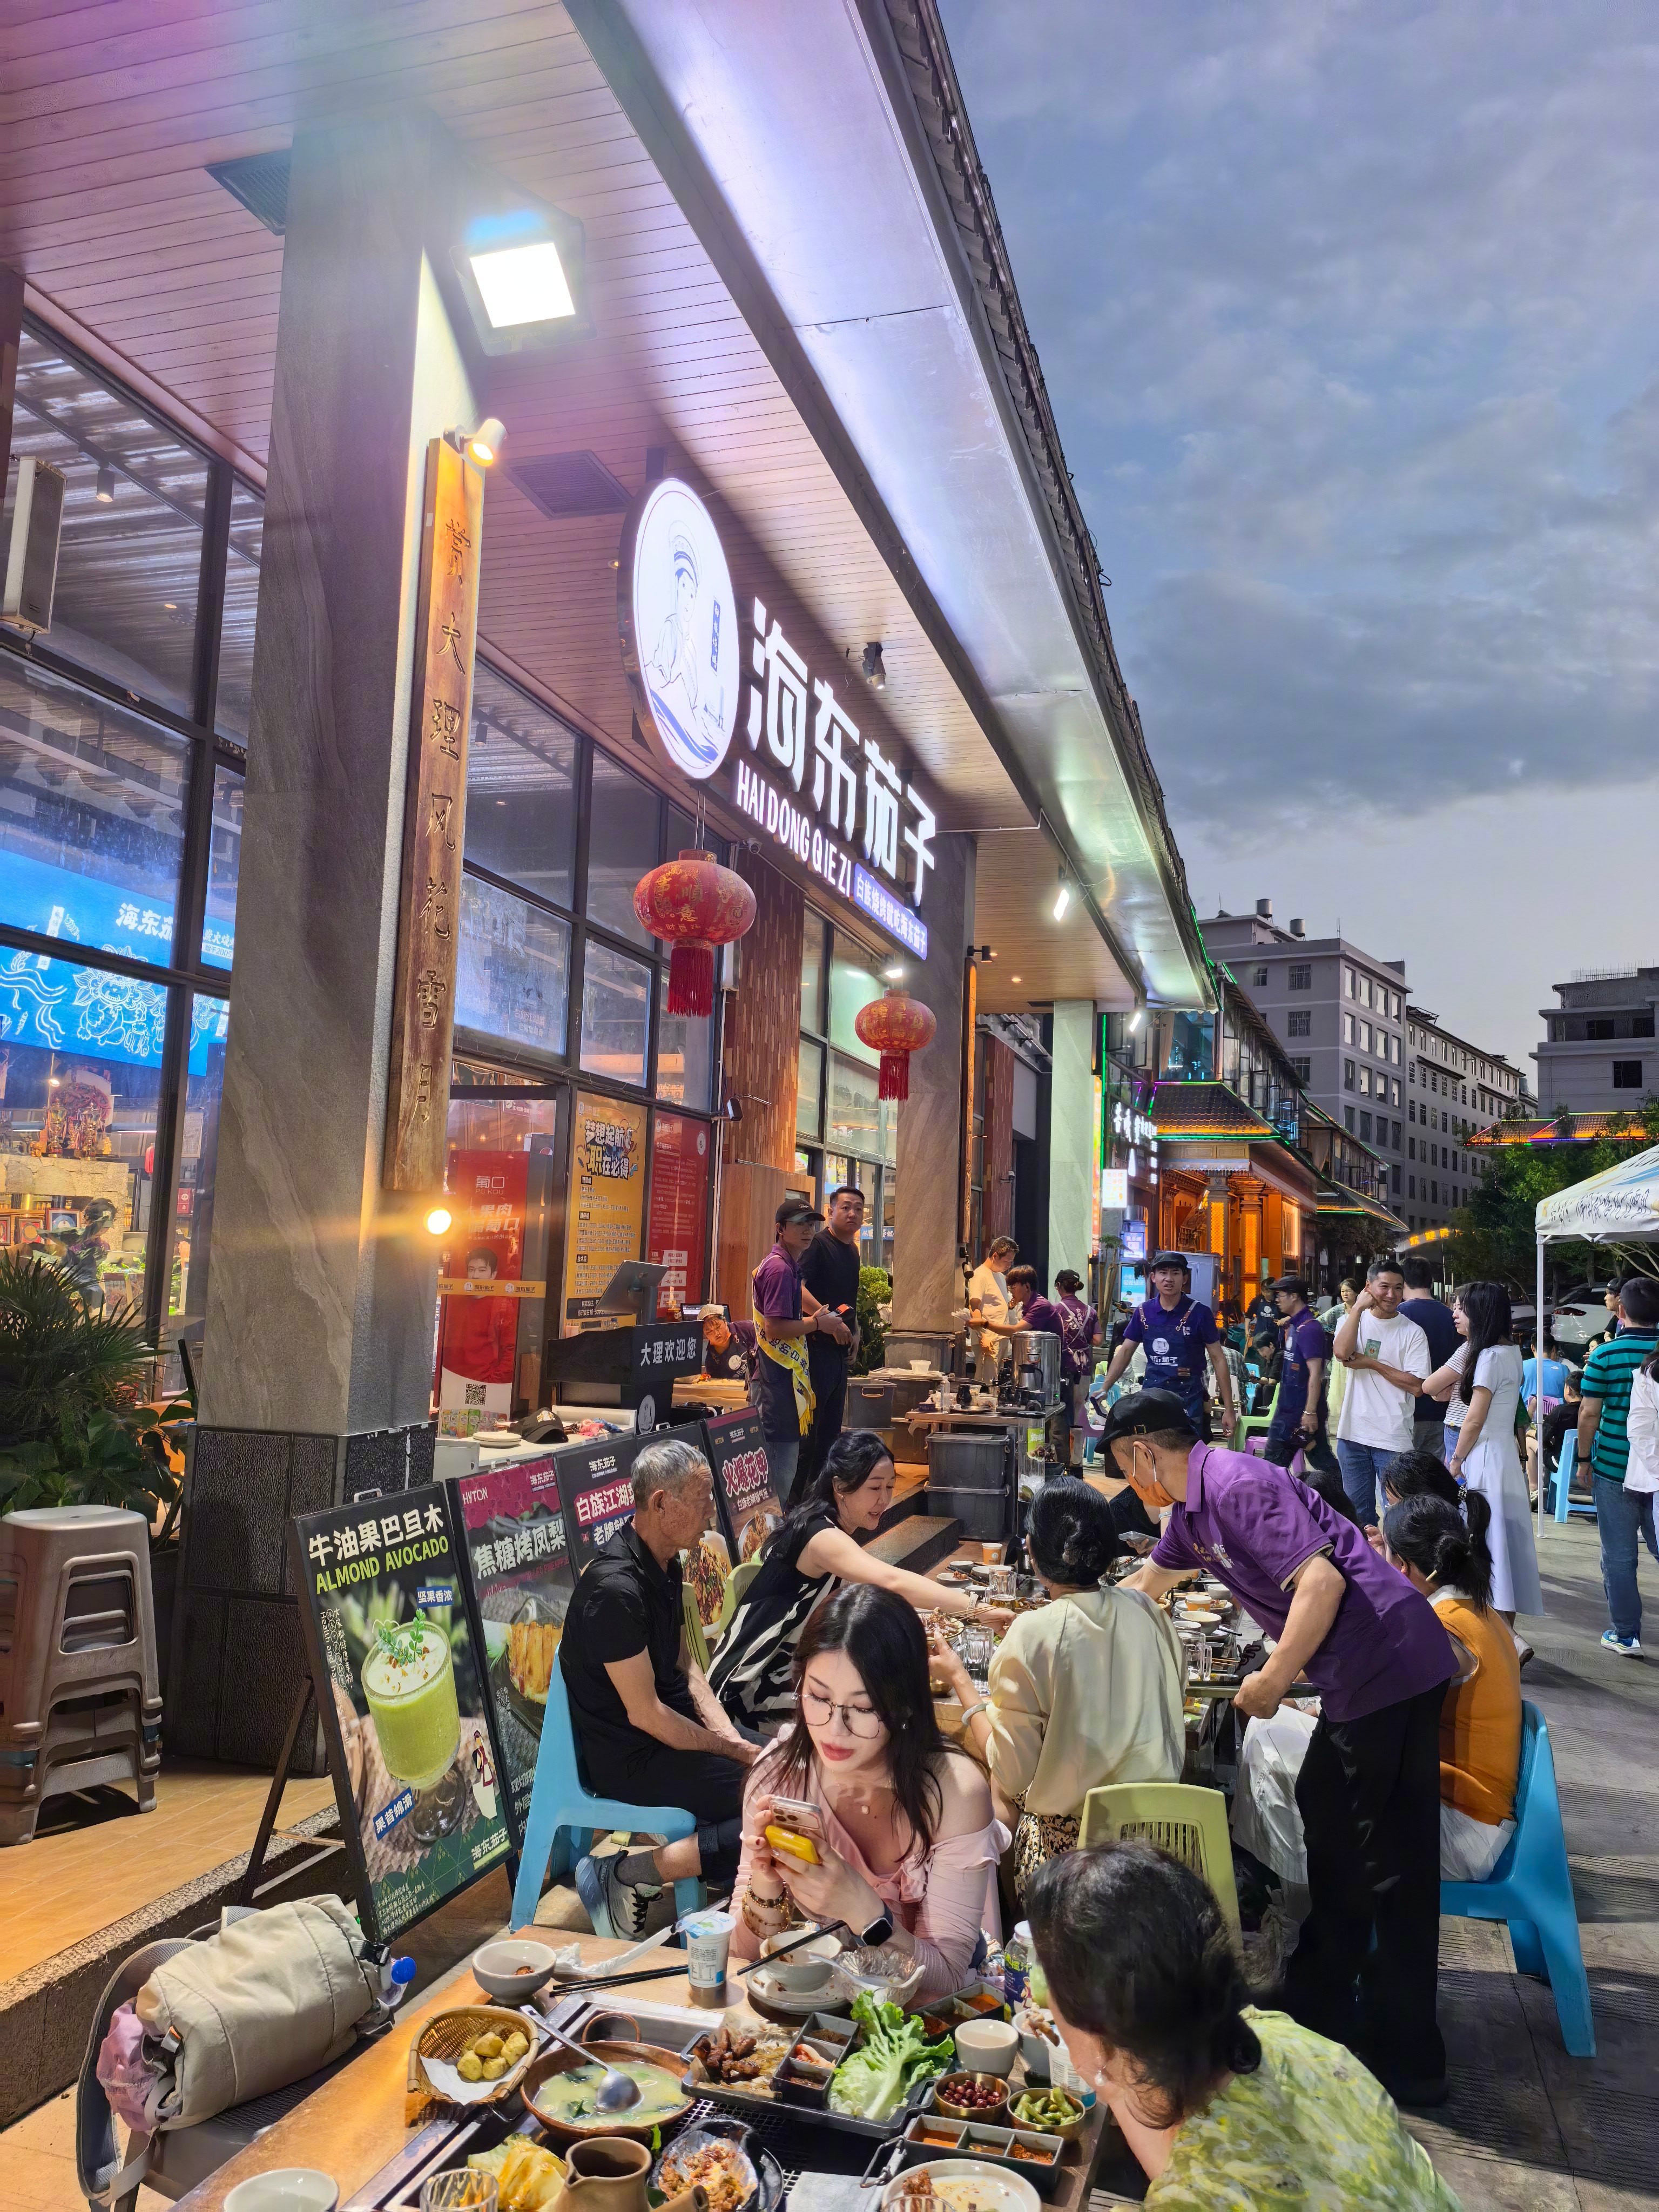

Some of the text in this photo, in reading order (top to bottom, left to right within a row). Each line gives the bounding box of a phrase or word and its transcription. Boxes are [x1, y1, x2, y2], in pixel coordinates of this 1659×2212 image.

[748, 596, 935, 907] 海东茄子
[737, 759, 852, 898] HAI DONG QIE ZI
[585, 1118, 625, 1148] 梦想起航
[476, 1176, 505, 1189] 葡口
[640, 1337, 696, 1367] 大理欢迎您
[530, 1469, 555, 1486] 海东茄子
[589, 1456, 616, 1472] 海东茄子
[723, 1446, 768, 1498] 火爆花甲
[463, 1487, 488, 1505] HYTON
[308, 1503, 444, 1567] 牛油果巴旦木
[474, 1518, 566, 1580] 焦糖烤凤梨
[316, 1535, 449, 1594] ALMOND AVOCADO
[417, 1590, 453, 1603] 坚果香浓
[320, 1611, 331, 1642] Health
[327, 1645, 335, 1663] and
[375, 1793, 412, 1834] 果昔绵滑
[471, 1827, 507, 1860] 海东茄子
